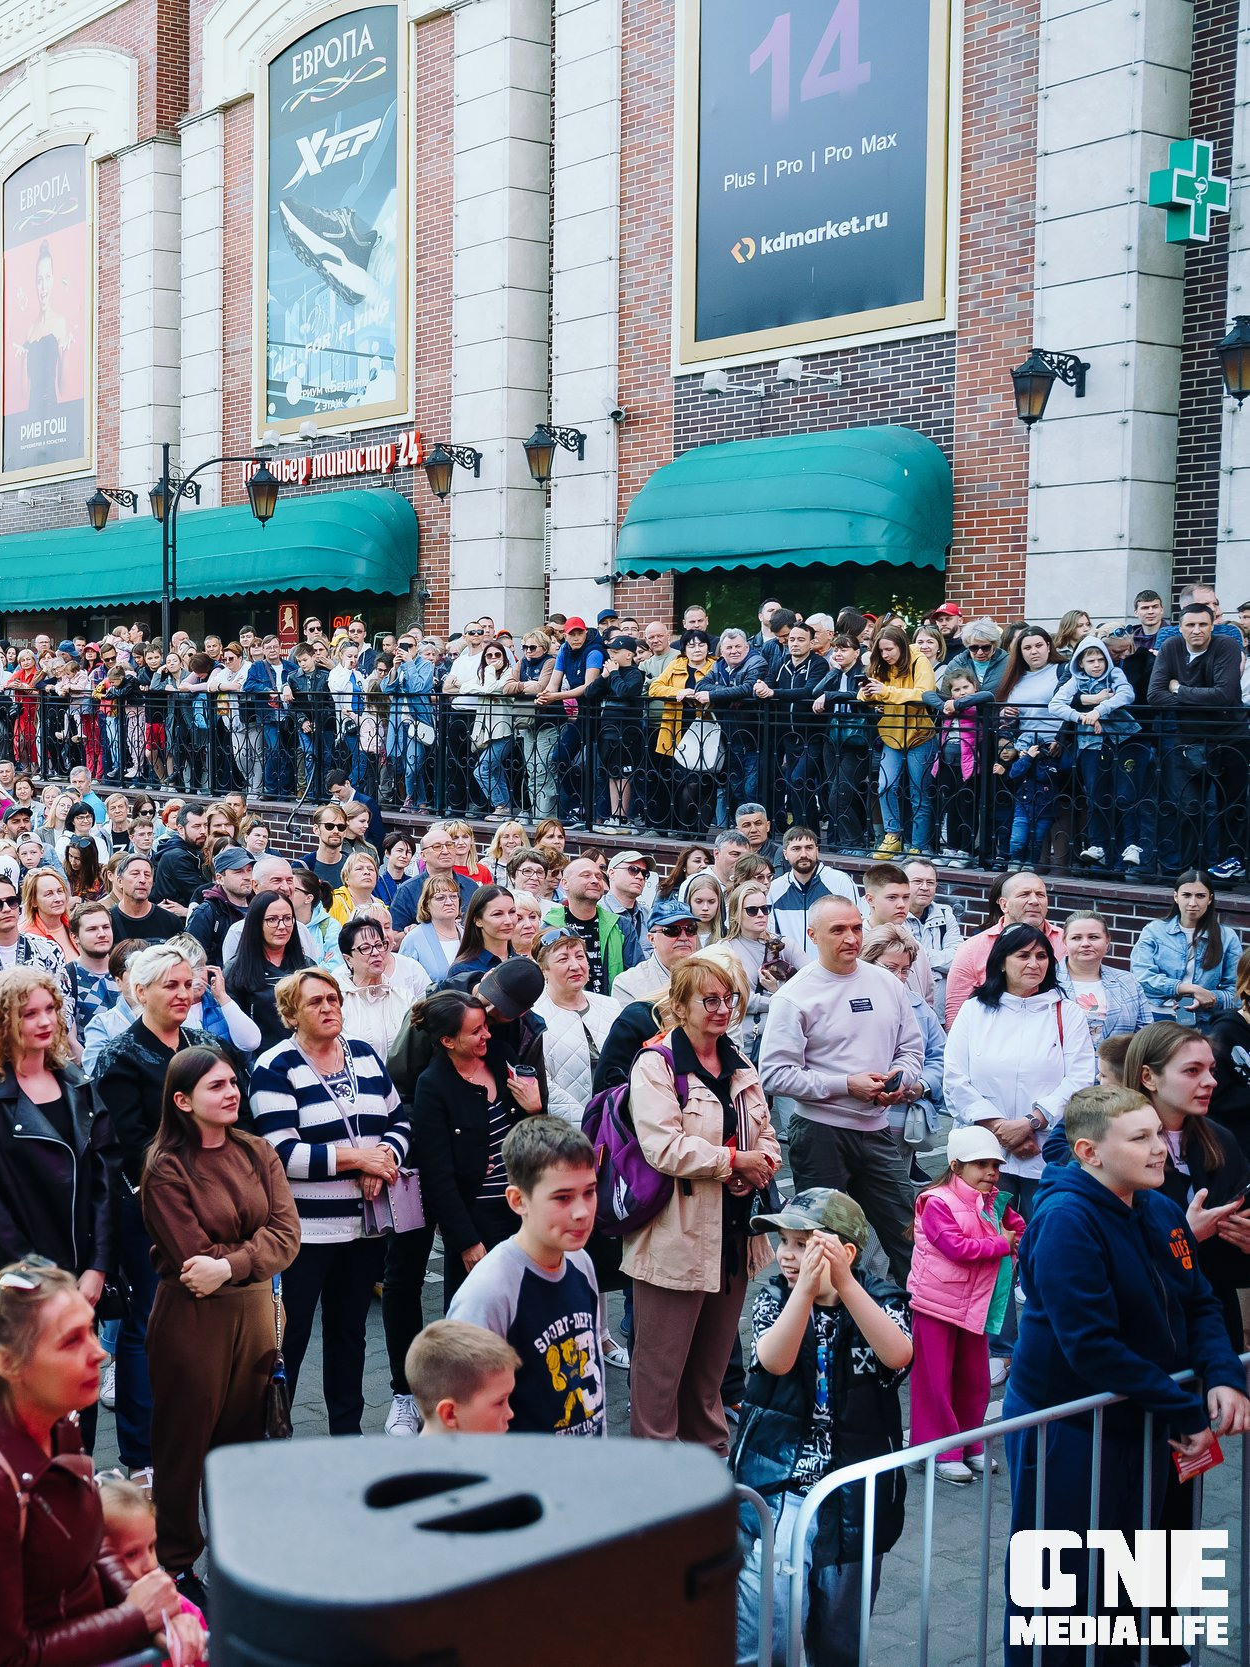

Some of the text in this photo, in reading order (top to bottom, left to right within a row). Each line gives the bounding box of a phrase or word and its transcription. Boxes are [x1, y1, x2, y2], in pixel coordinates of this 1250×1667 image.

[292, 23, 375, 85] ЕВРОПА
[750, 0, 871, 122] 14
[282, 117, 382, 191] XTEP
[724, 170, 756, 191] Plus
[776, 158, 803, 178] Pro
[824, 144, 853, 165] Pro
[861, 131, 898, 155] Max
[20, 171, 71, 211] ЕВРОПА
[760, 211, 889, 255] kdmarket.ru
[43, 416, 67, 436] ГОШ
[314, 401, 321, 412] 2
[399, 430, 424, 467] 24
